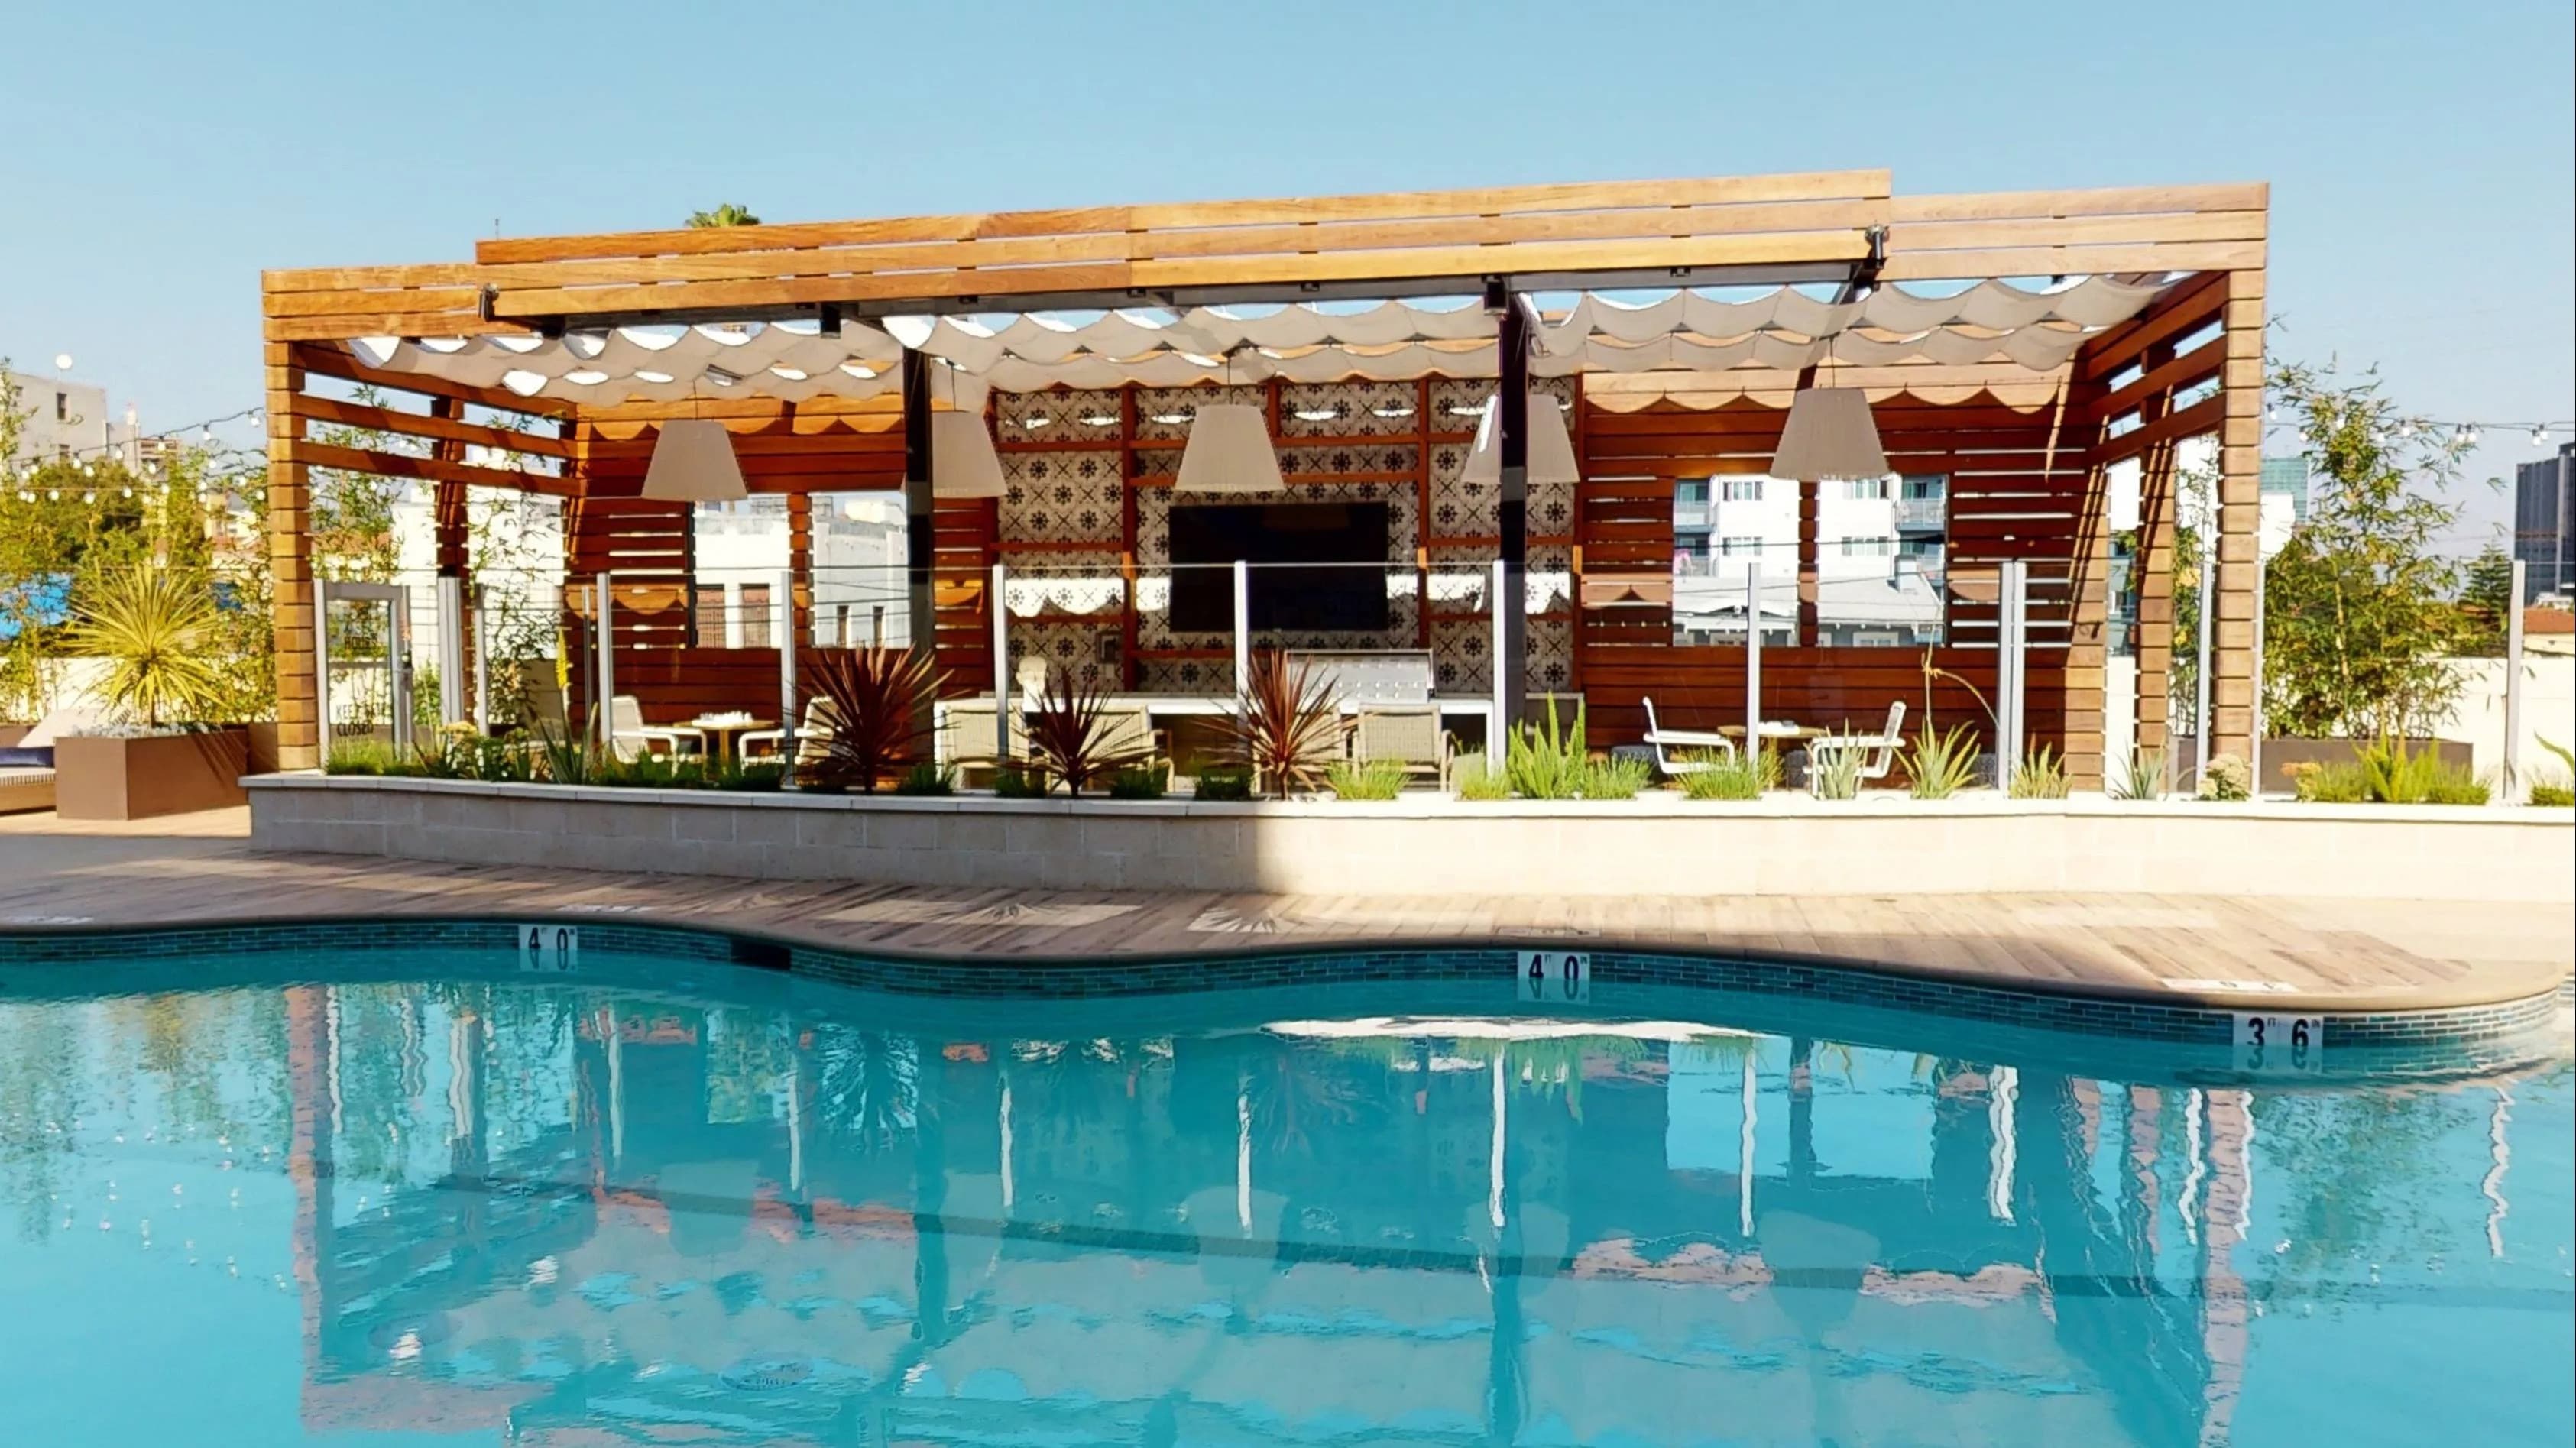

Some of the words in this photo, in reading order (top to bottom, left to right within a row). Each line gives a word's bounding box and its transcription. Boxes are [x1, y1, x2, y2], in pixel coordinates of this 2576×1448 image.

[529, 927, 541, 949] 4
[556, 928, 569, 951] 0
[1528, 954, 1544, 979] 4
[1564, 955, 1579, 981] 0
[2247, 1017, 2264, 1046] 3
[2292, 1019, 2309, 1047] 6
